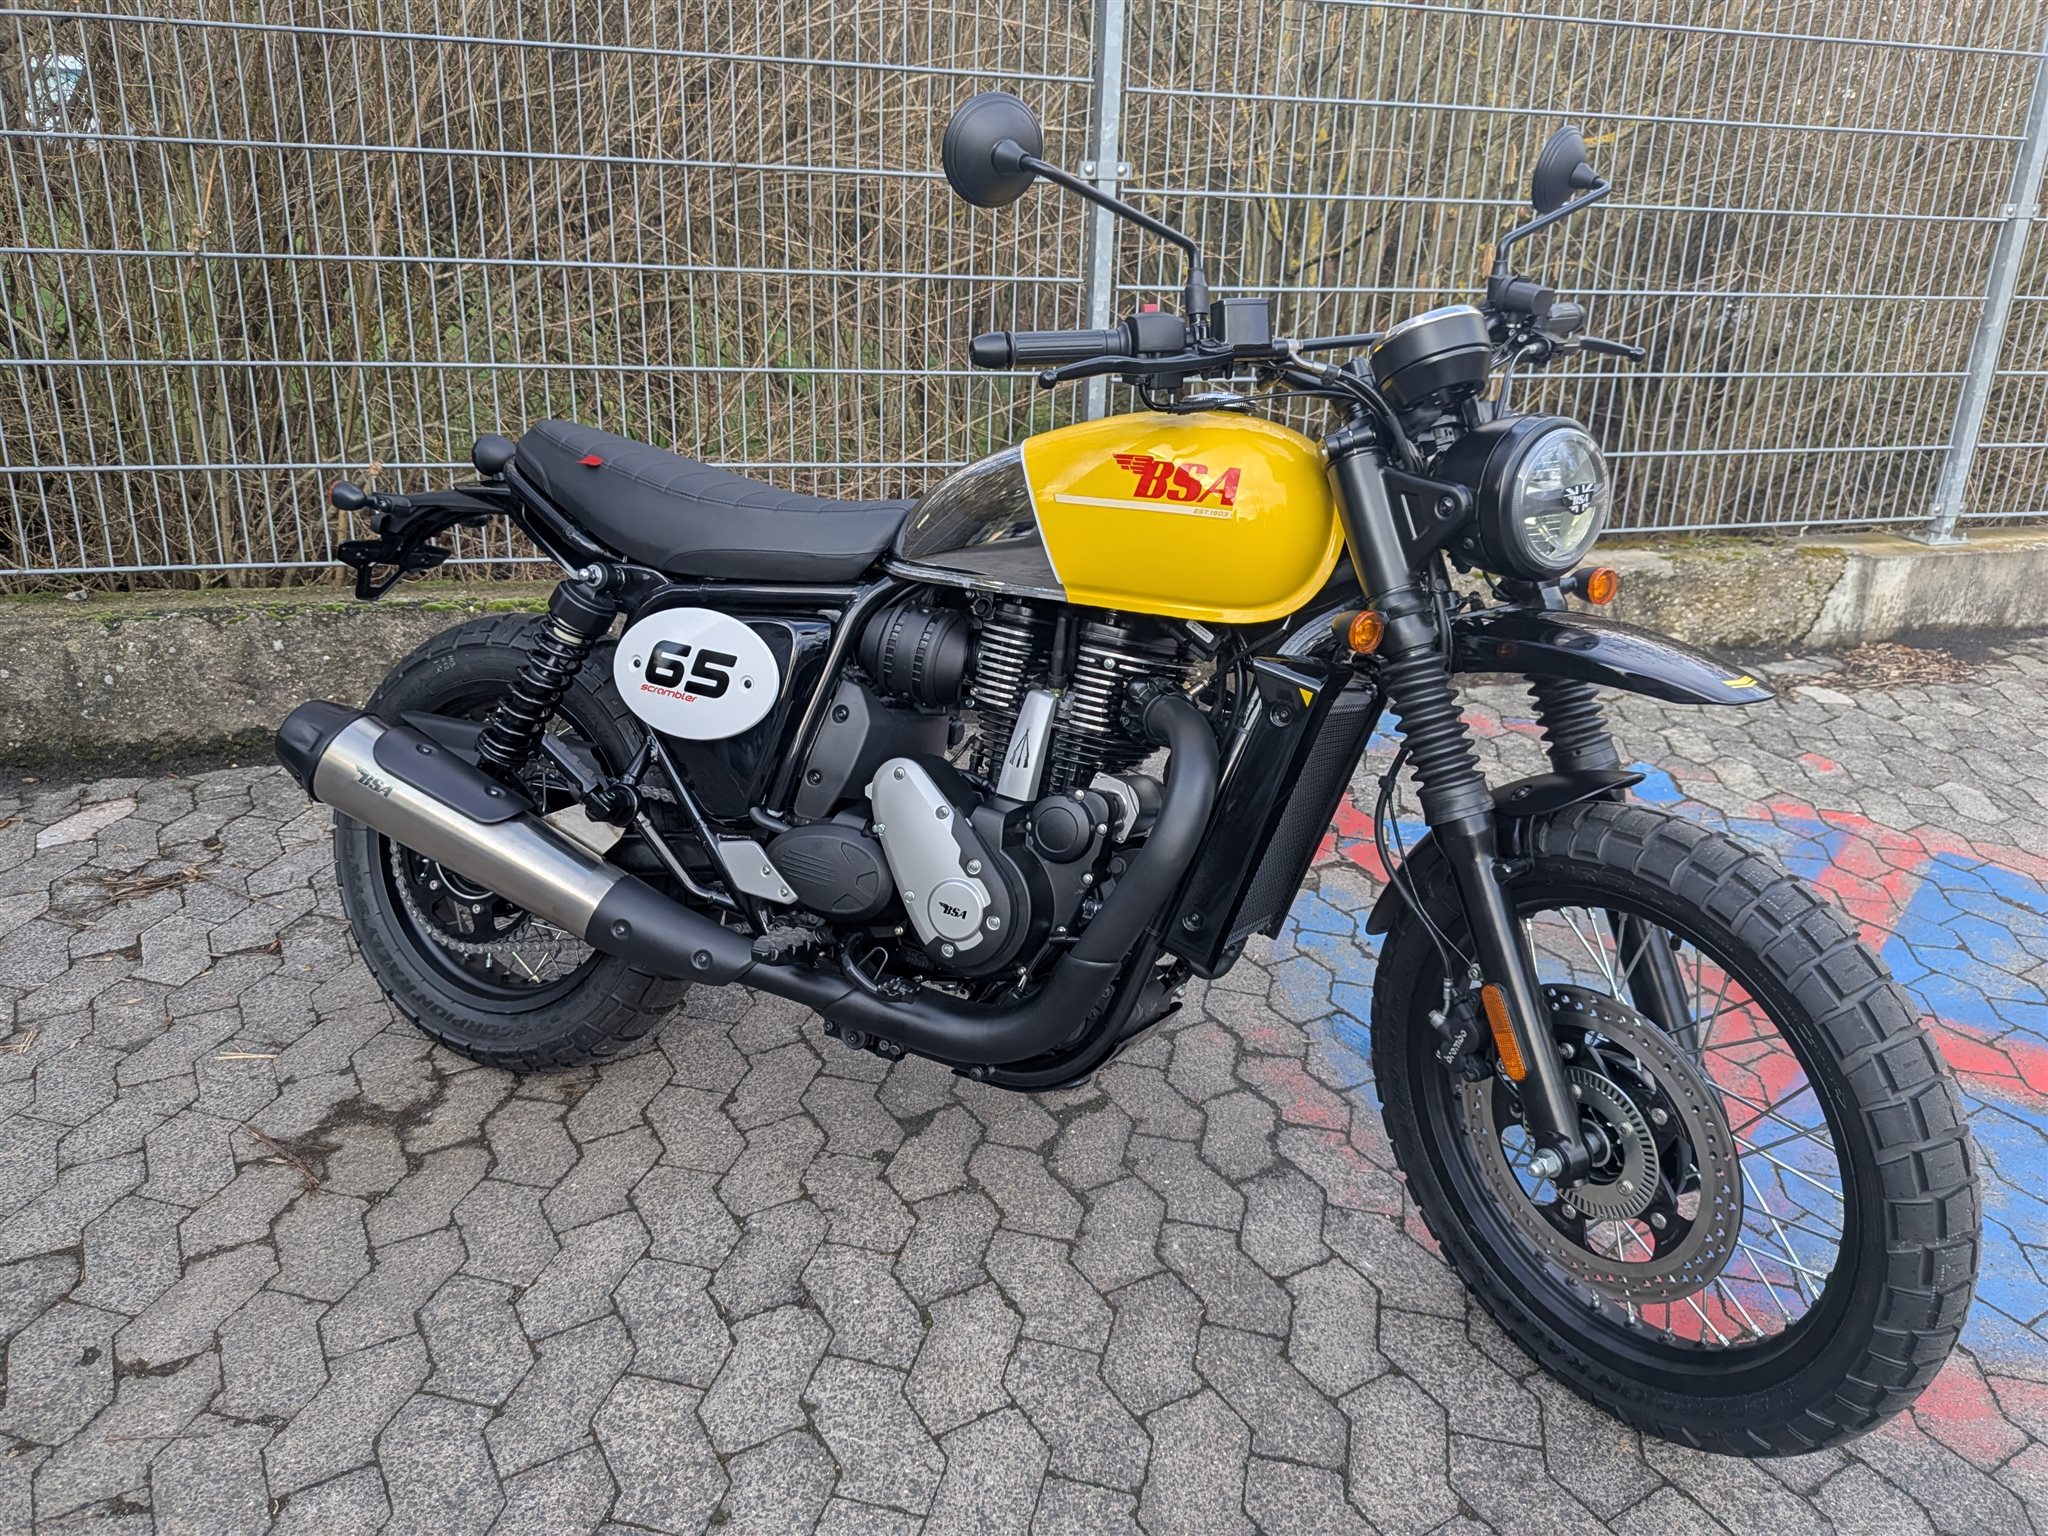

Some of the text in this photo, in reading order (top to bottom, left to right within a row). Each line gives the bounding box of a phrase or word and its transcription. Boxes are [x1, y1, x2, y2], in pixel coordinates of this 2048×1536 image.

[1134, 460, 1241, 506] BSA
[645, 640, 738, 699] 65
[640, 683, 697, 703] scrambler
[358, 769, 393, 798] BSA
[942, 904, 967, 920] BSA
[1443, 1029, 1467, 1064] brembo
